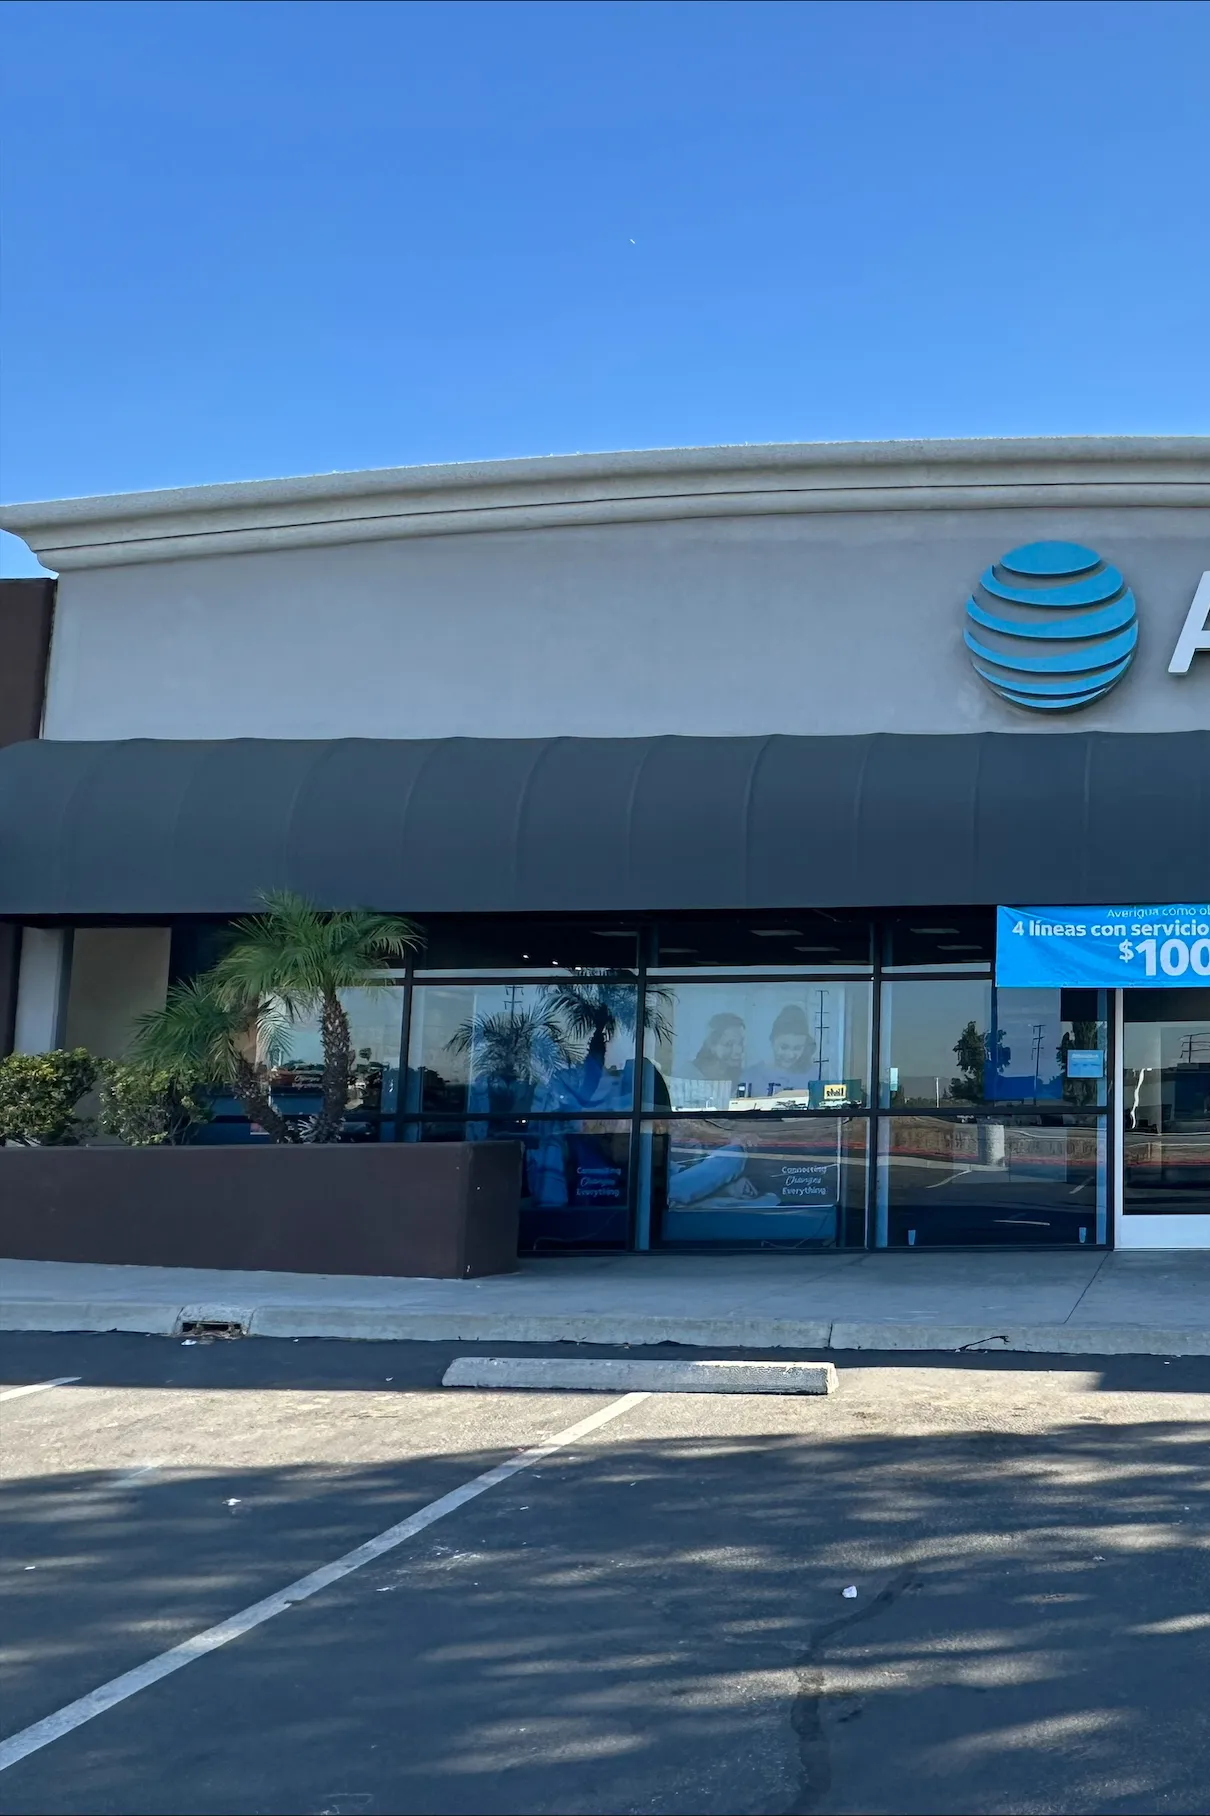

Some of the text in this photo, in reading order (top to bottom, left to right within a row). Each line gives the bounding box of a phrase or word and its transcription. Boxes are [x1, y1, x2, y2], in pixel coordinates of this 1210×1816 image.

[1107, 906, 1159, 919] Averigua
[1012, 920, 1025, 936] 4
[1029, 919, 1086, 937] líneas
[1090, 924, 1126, 937] con
[1130, 919, 1210, 937] servicio
[782, 1187, 826, 1196] Everything
